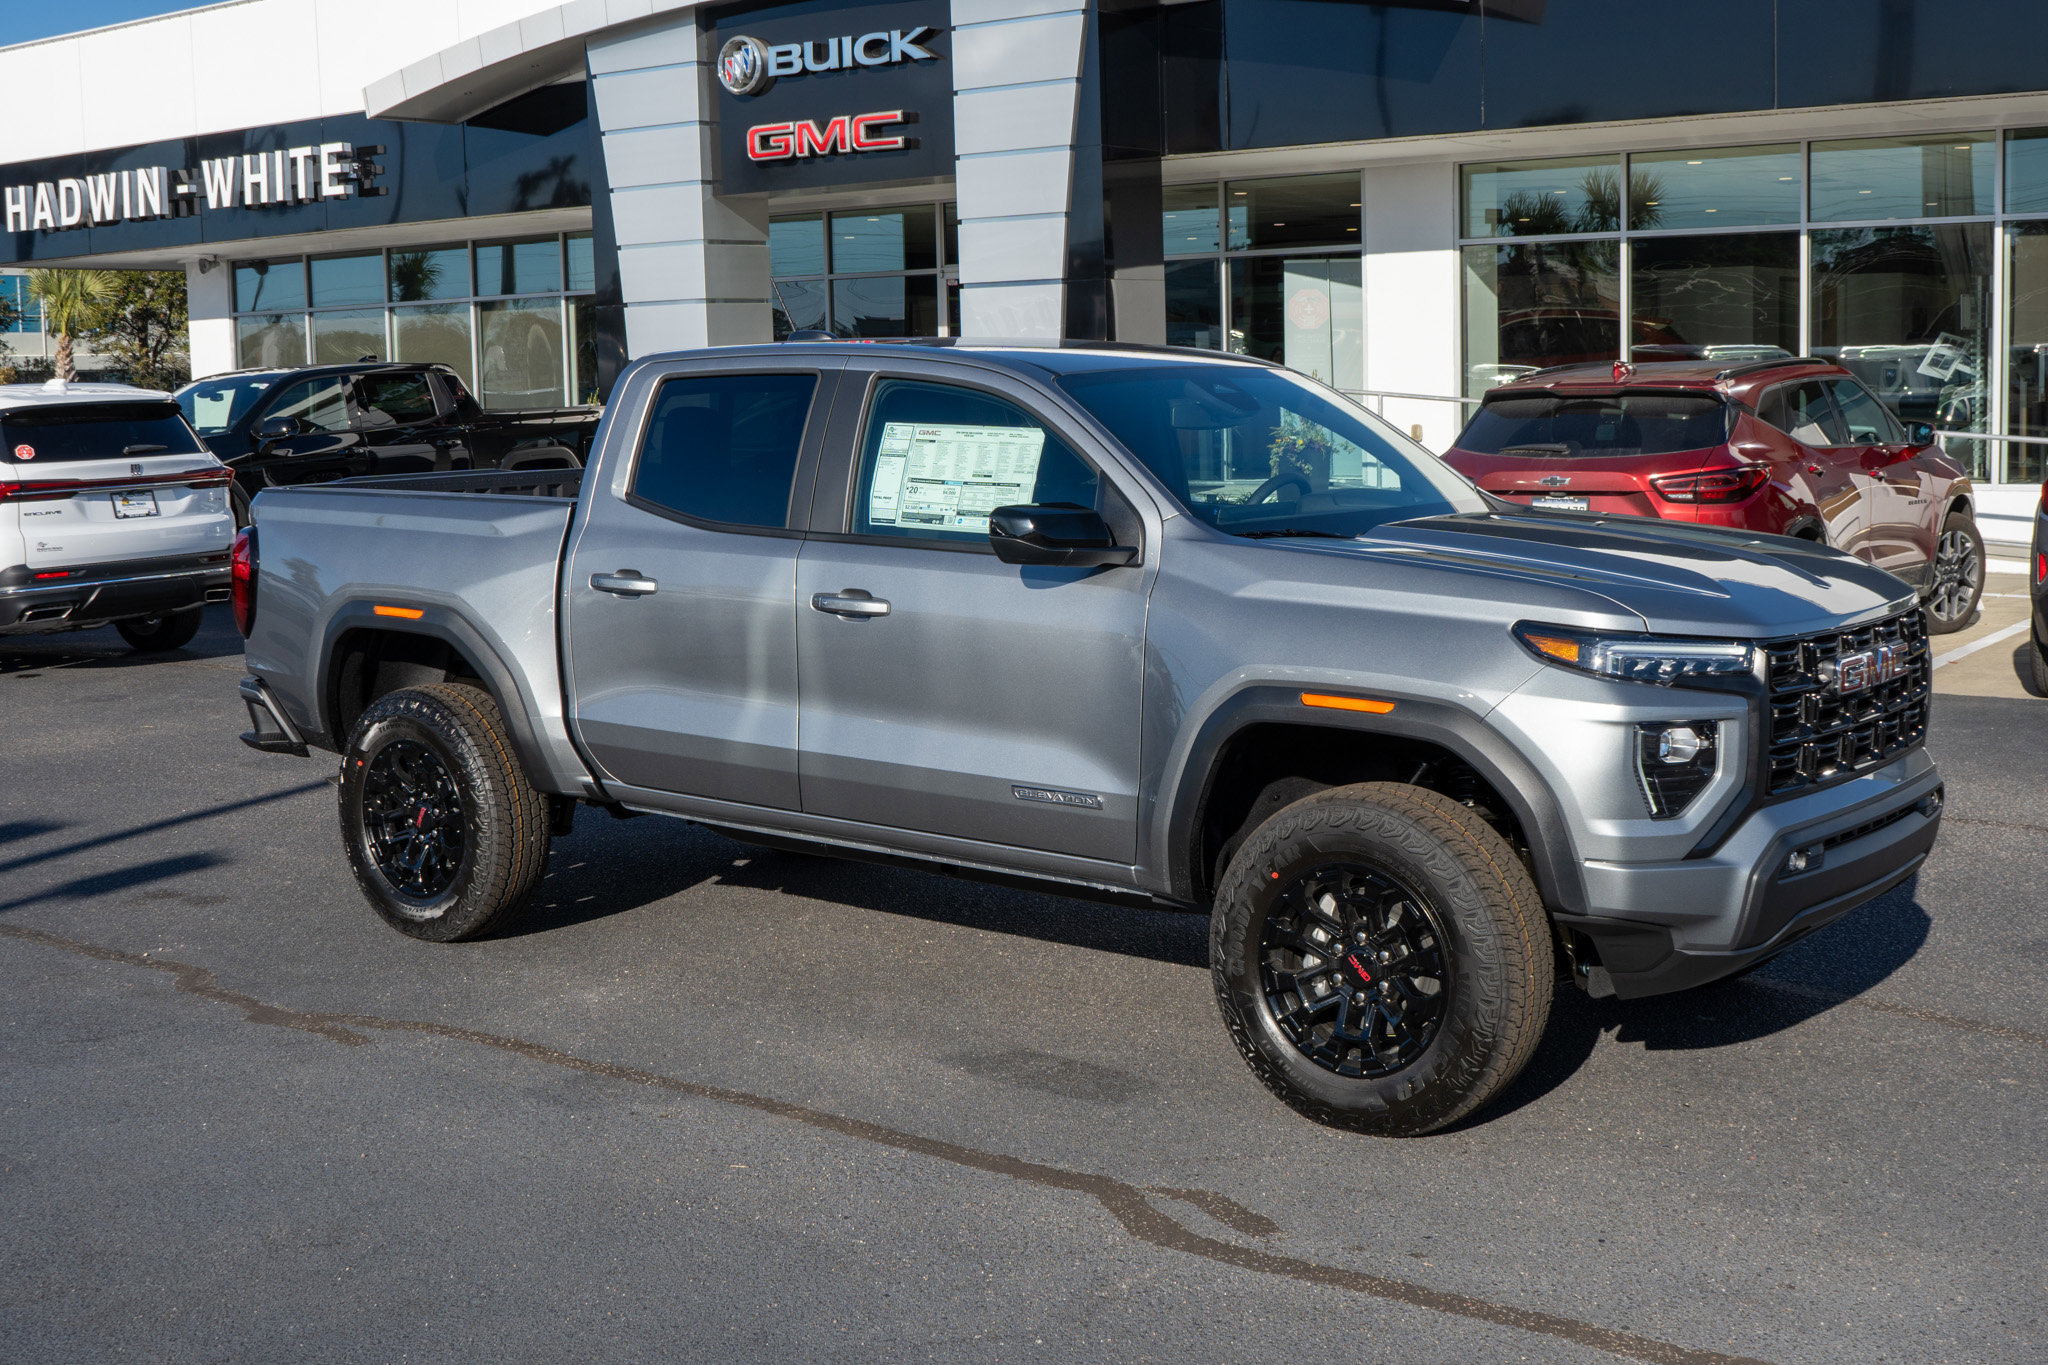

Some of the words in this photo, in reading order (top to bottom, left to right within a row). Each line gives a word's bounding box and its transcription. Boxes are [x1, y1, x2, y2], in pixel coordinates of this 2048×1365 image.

[768, 26, 931, 77] BUICK
[747, 109, 905, 161] GMC
[201, 142, 353, 210] WHITE
[23, 509, 62, 517] ENCLAVE
[1840, 643, 1908, 695] GMC
[1017, 788, 1096, 806] ELEVATION
[1348, 954, 1371, 982] GMC
